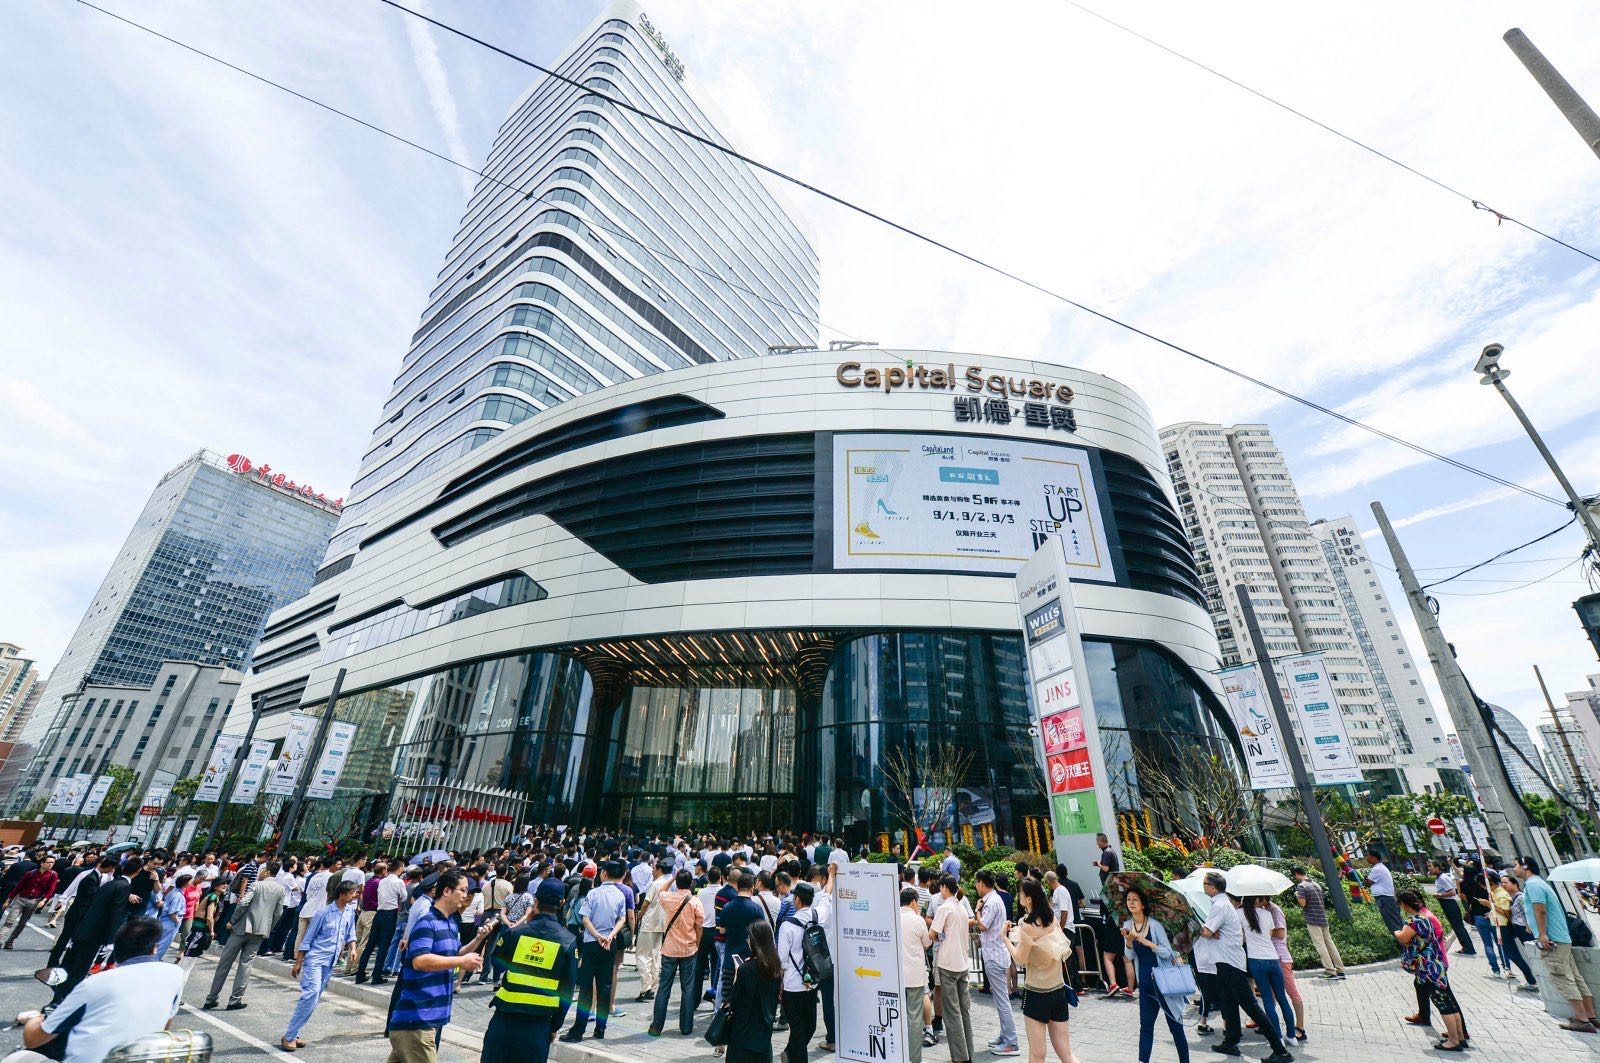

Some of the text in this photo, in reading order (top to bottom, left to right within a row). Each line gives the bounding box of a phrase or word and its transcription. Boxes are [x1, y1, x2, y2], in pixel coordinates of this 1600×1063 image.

[836, 359, 1074, 404] Capital Square
[921, 444, 954, 454] CapitaLand
[1043, 484, 1079, 498] START
[922, 494, 970, 503] 精选美食与购物
[1045, 495, 1083, 523] UP
[1029, 519, 1062, 533] STEP
[955, 529, 997, 538] 仅限开业三天
[1256, 722, 1272, 735] UP
[1247, 742, 1263, 757] IN
[1066, 761, 1091, 778] 汉堡王
[878, 997, 898, 1008] START
[878, 1007, 899, 1028] UP
[868, 1025, 886, 1036] STEP
[869, 1035, 886, 1060] IN
